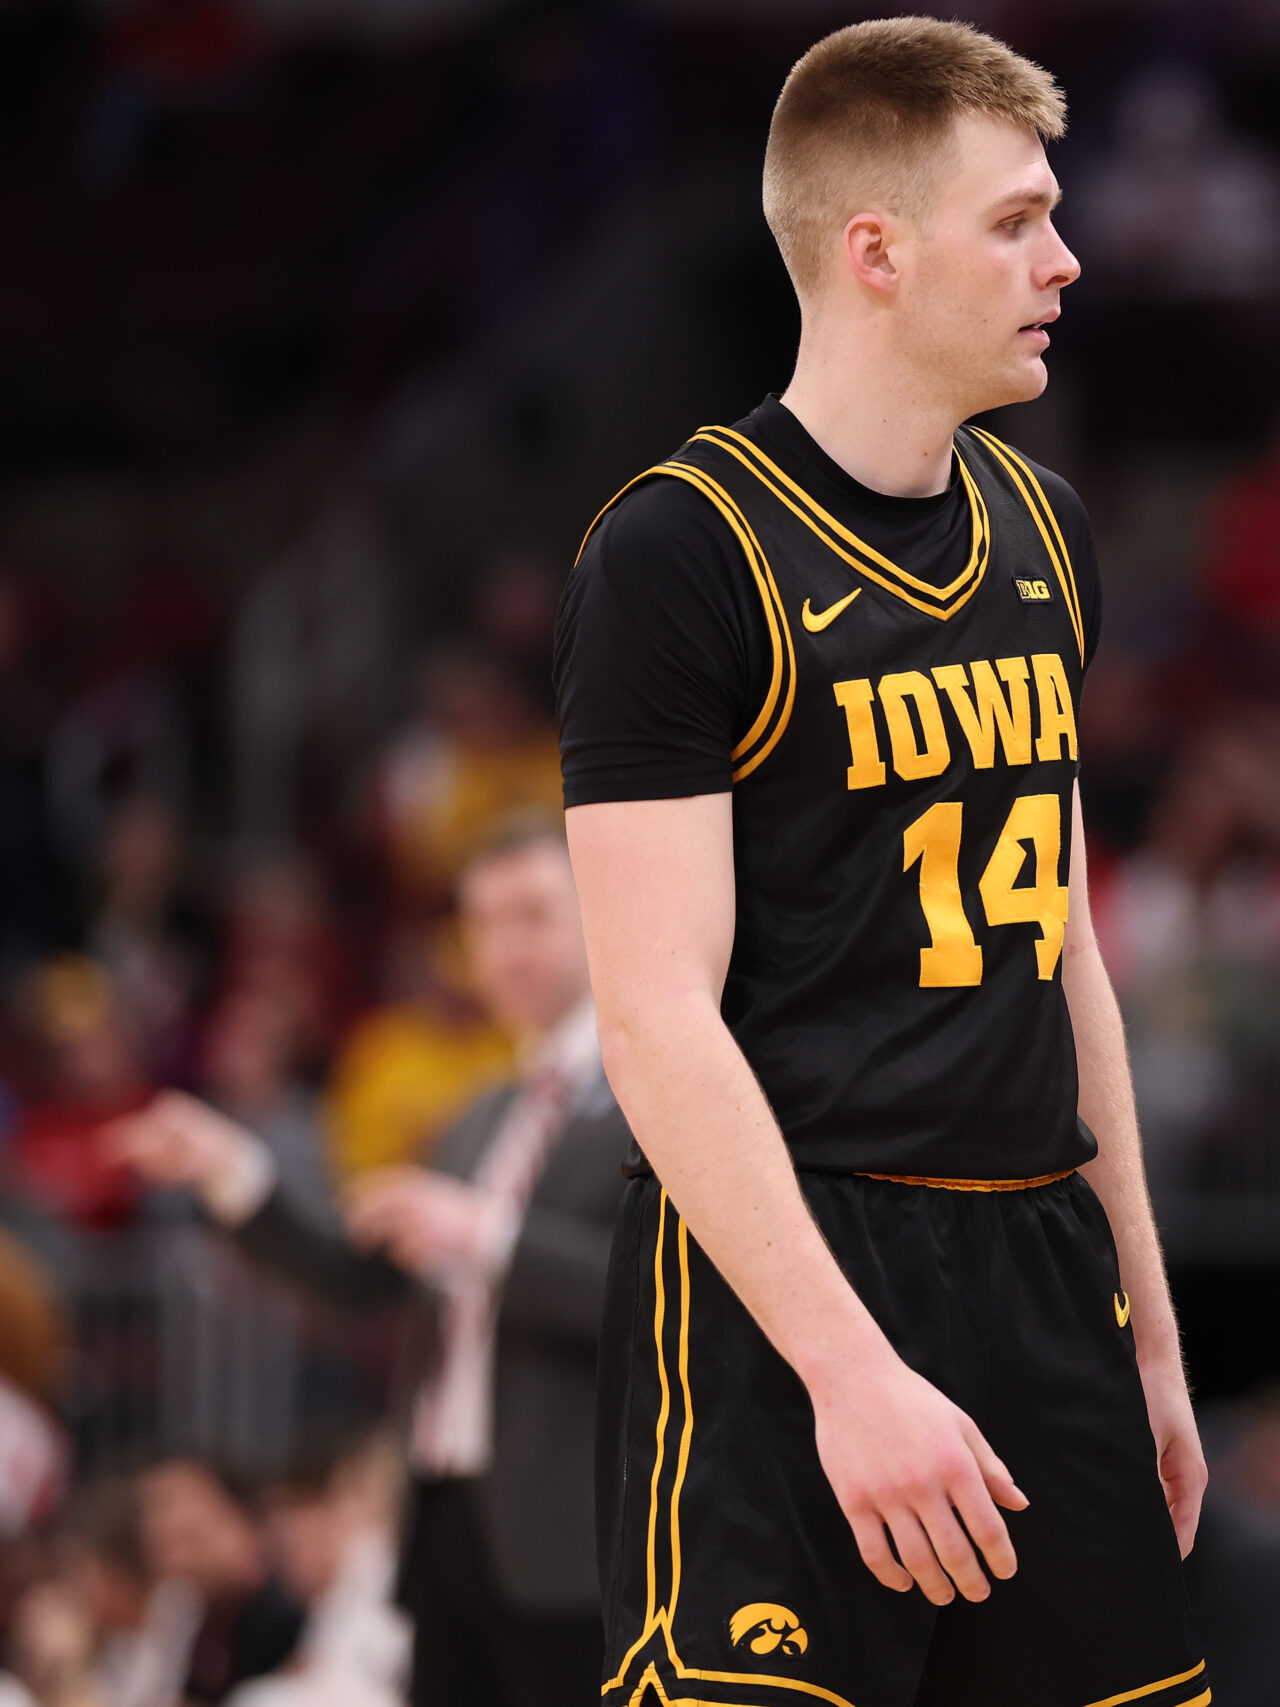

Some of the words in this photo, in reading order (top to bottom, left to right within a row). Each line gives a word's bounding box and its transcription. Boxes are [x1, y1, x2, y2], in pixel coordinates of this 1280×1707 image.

[1016, 580, 1050, 599] BIG
[833, 653, 1078, 790] IOWA
[903, 794, 1069, 987] 14
